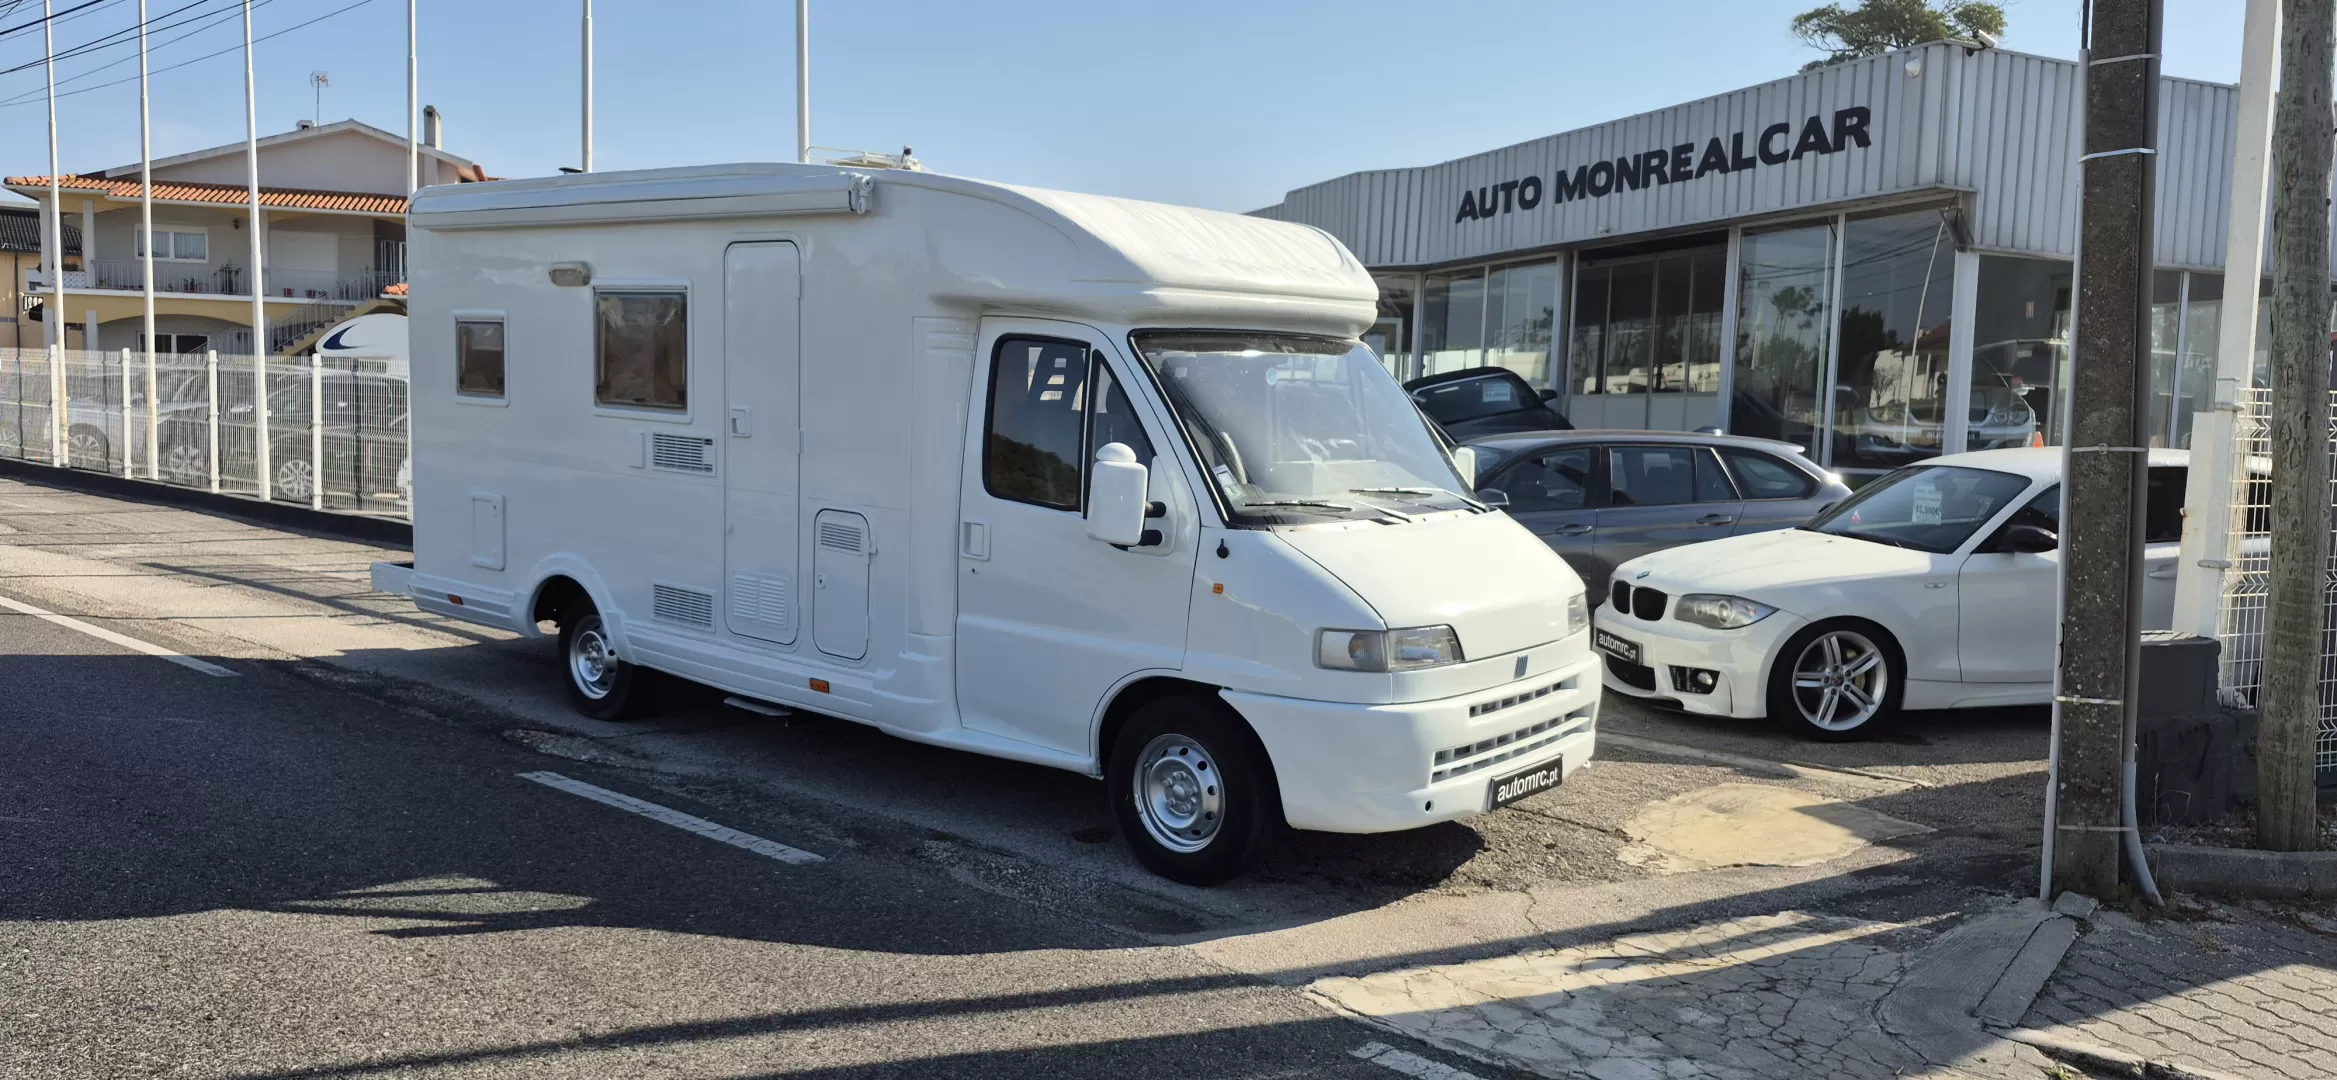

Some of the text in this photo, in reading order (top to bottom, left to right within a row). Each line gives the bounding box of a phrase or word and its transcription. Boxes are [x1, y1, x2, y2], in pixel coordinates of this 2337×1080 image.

[1455, 106, 1872, 224] AUTO MONREALCAR
[1598, 633, 1636, 660] automrc.pt
[1497, 767, 1558, 802] automrc.pt
